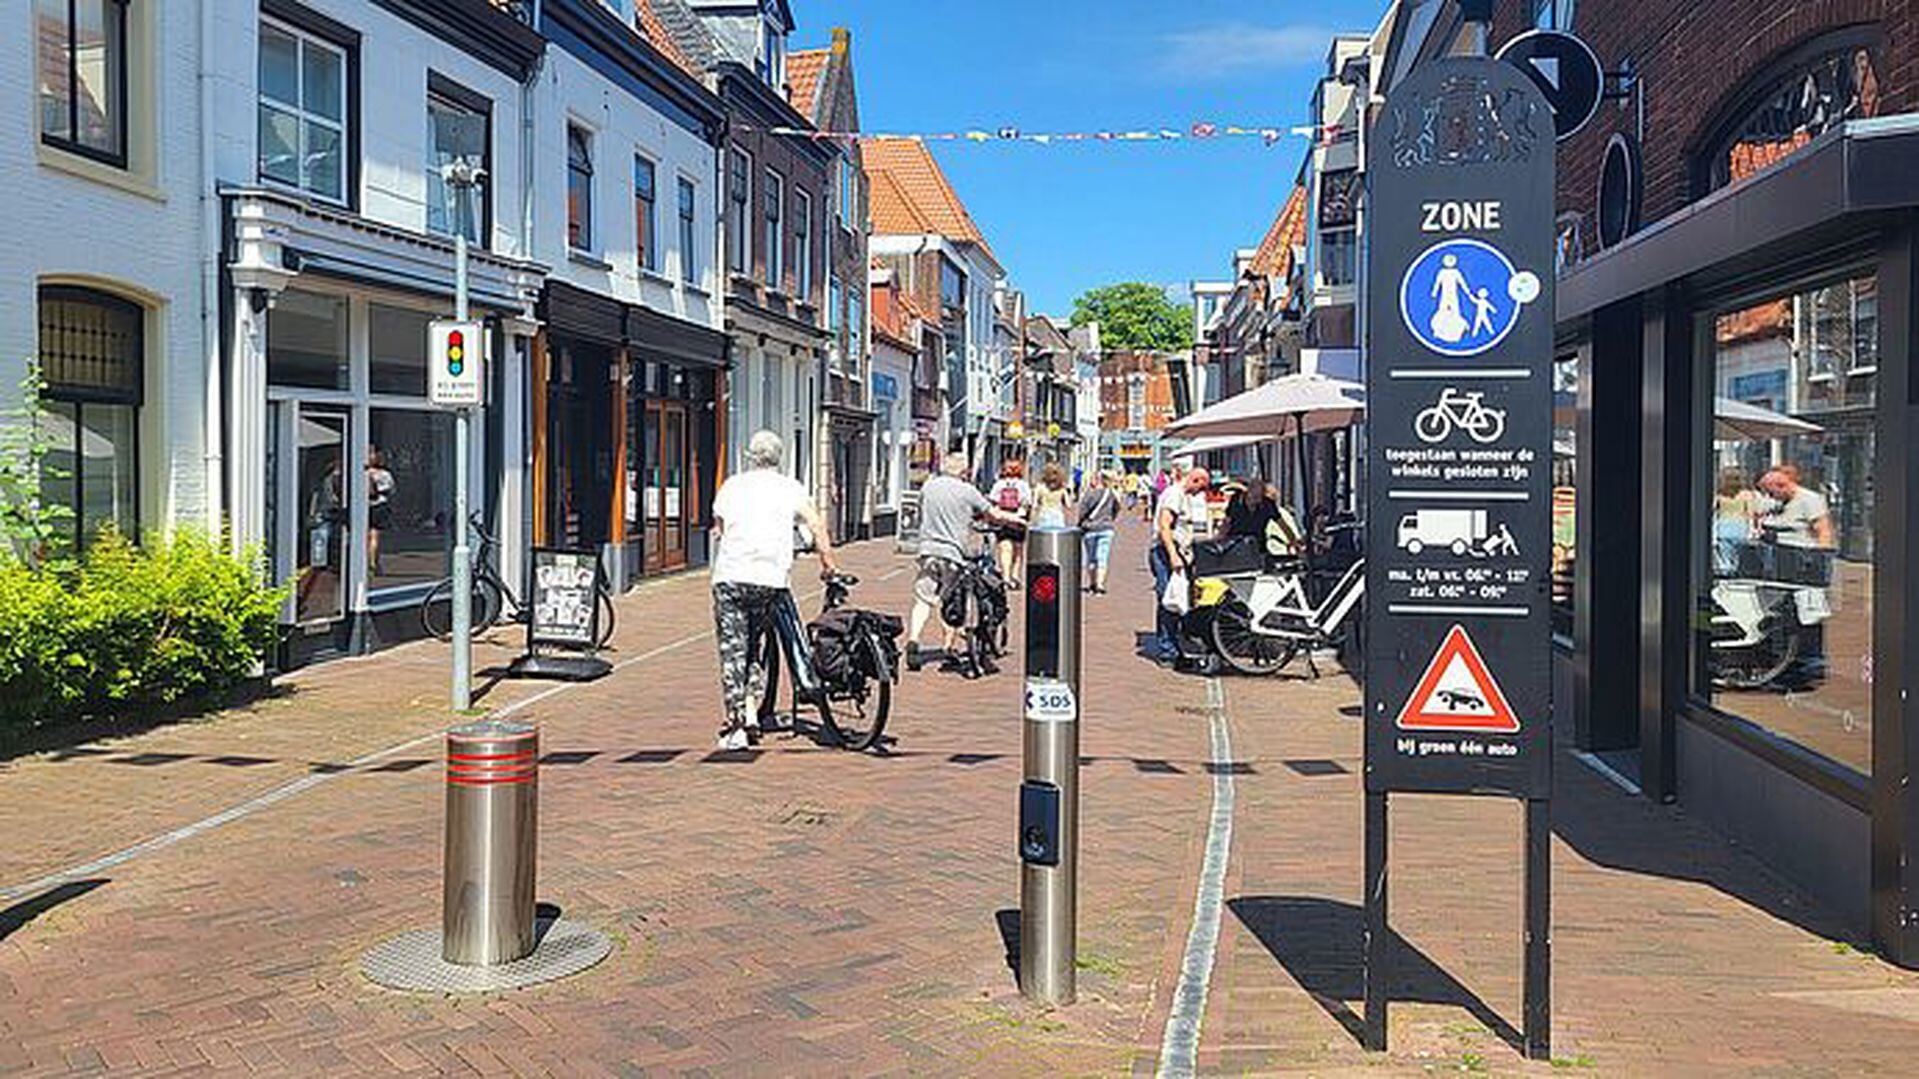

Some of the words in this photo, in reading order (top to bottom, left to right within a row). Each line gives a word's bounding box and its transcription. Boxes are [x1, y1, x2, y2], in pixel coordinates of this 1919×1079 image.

[1421, 201, 1501, 231] ZONE
[1385, 448, 1456, 463] toegestaan
[1460, 450, 1514, 461] wanneer
[1517, 448, 1534, 461] de
[1391, 463, 1440, 477] winkels
[1443, 464, 1499, 480] gesloten
[1502, 464, 1529, 481] zijn
[1388, 570, 1412, 581] ma.
[1416, 568, 1440, 583] t/m
[1410, 585, 1435, 597] zat.
[1397, 739, 1416, 756] bij
[1419, 742, 1456, 756] groen
[1487, 743, 1518, 756] auto
